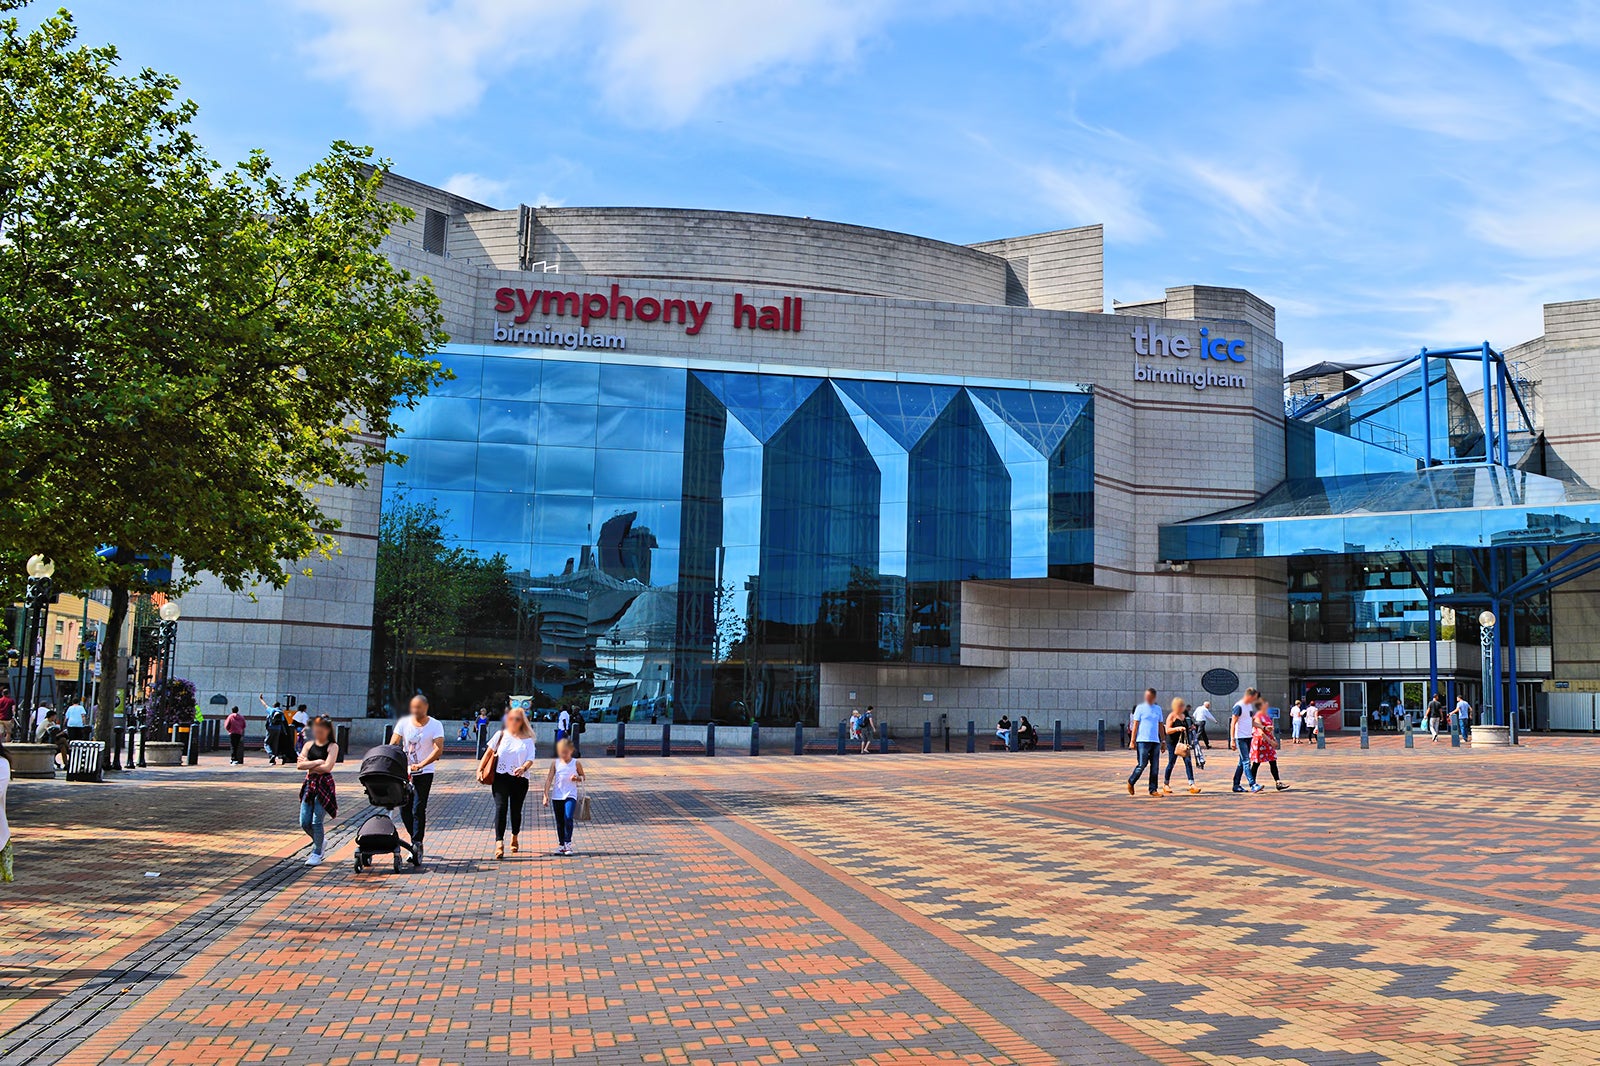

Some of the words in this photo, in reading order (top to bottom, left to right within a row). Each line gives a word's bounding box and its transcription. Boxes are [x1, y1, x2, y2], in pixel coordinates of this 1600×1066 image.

[494, 283, 713, 335] symphony
[733, 293, 803, 332] hall
[493, 320, 627, 351] birmingham
[1130, 322, 1192, 358] the
[1199, 326, 1247, 363] icc
[1134, 363, 1247, 390] birmingham
